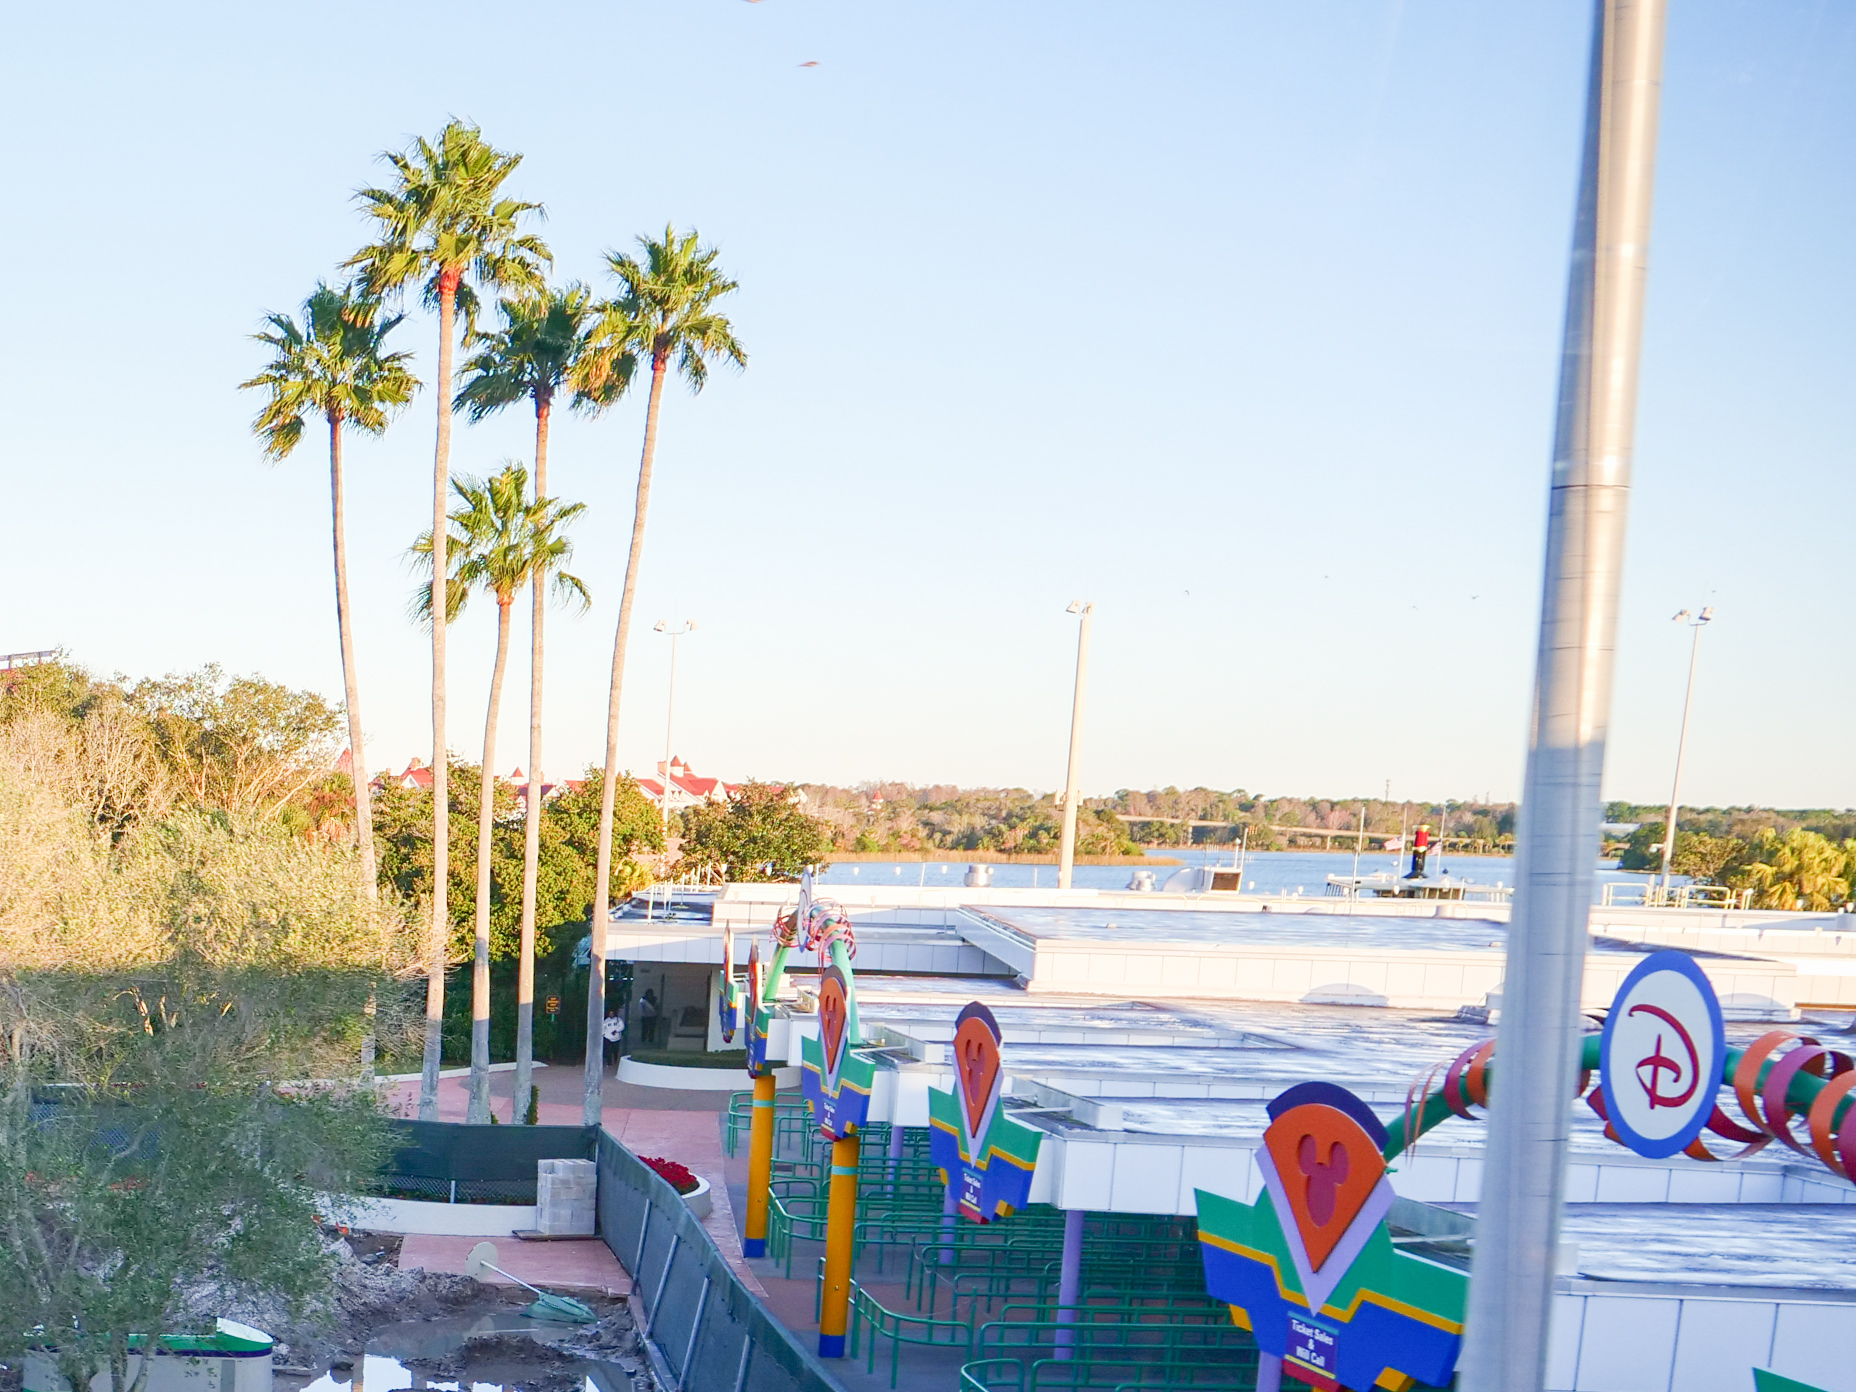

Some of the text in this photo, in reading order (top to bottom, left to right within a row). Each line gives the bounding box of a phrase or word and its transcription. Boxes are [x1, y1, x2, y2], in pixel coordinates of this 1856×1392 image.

[1628, 1003, 1700, 1110] D
[1291, 1319, 1334, 1346] Ticket Sales
[1308, 1338, 1315, 1350] &
[1310, 1352, 1326, 1367] Call
